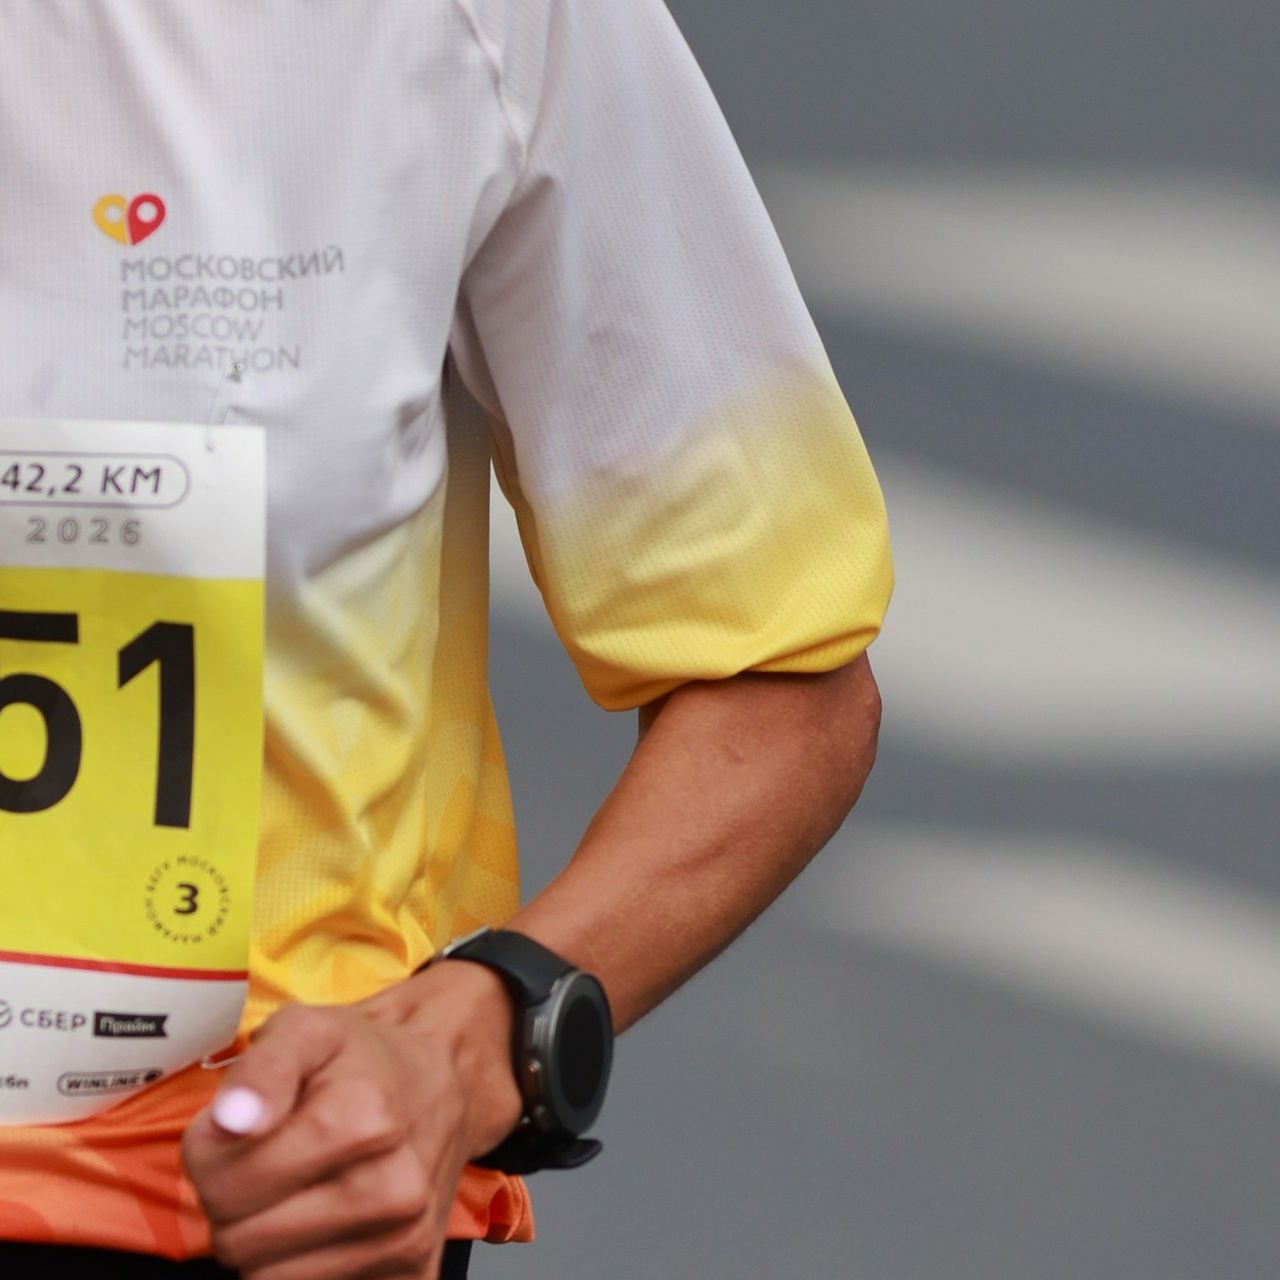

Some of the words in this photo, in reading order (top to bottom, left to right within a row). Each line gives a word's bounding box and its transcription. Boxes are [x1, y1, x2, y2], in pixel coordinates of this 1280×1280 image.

[121, 245, 345, 282] МОСКОВСКИЙ
[122, 285, 283, 312] МАРАФОН
[123, 314, 264, 342] MOSCOW
[125, 343, 300, 371] MARATHON
[0, 463, 84, 497] 42,2
[25, 516, 143, 547] 2026
[173, 882, 199, 916] 3
[20, 1007, 86, 1031] СБЕР
[99, 1015, 157, 1035] Прайм
[67, 1075, 140, 1090] WINLINE
